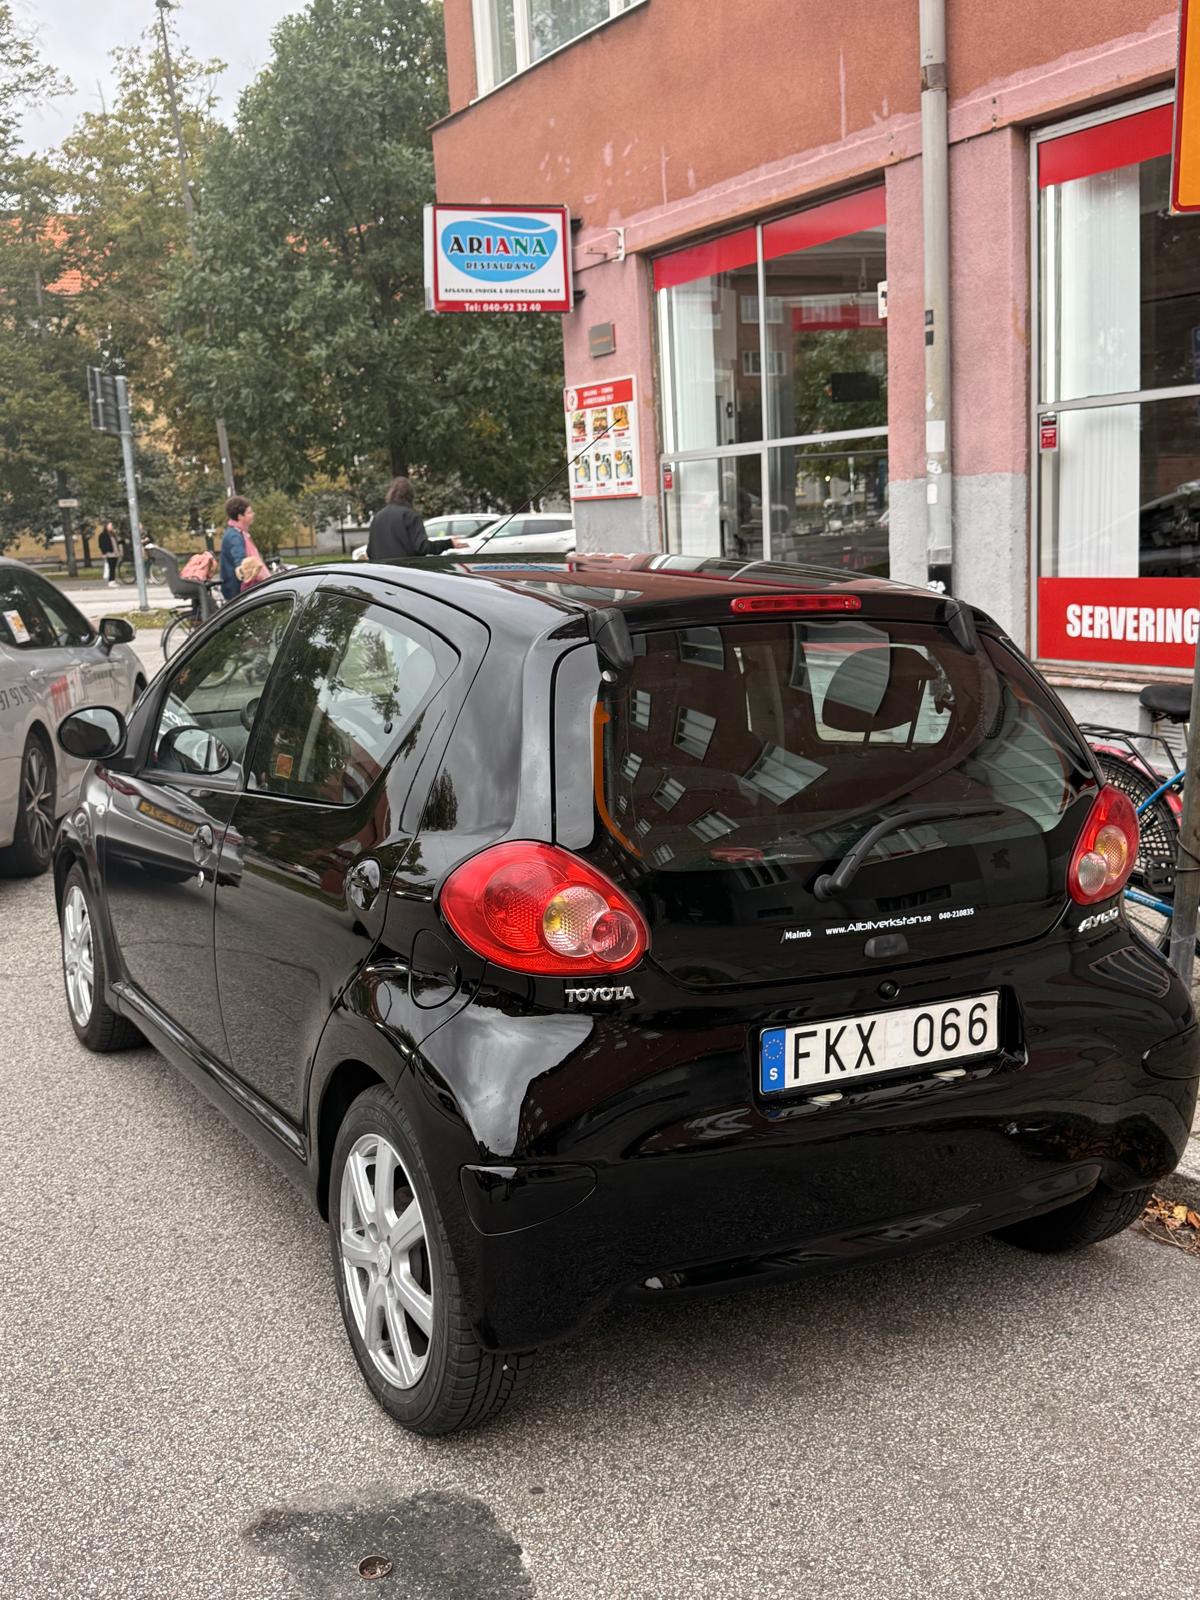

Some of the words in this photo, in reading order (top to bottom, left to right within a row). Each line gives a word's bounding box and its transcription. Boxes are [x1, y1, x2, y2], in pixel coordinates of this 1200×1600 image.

[449, 236, 547, 256] ARIANA
[466, 261, 536, 270] RESTAURANG
[464, 303, 481, 312] Tel:
[483, 303, 515, 312] 040-92
[517, 303, 528, 312] 32
[529, 303, 541, 312] 40
[1066, 604, 1200, 645] SERVERING
[785, 929, 812, 940] Malmö
[939, 908, 975, 920] 040-210835
[565, 986, 634, 1002] TOYOTA
[794, 1020, 876, 1080] FKX
[913, 1003, 987, 1057] 066
[769, 1067, 779, 1081] S
